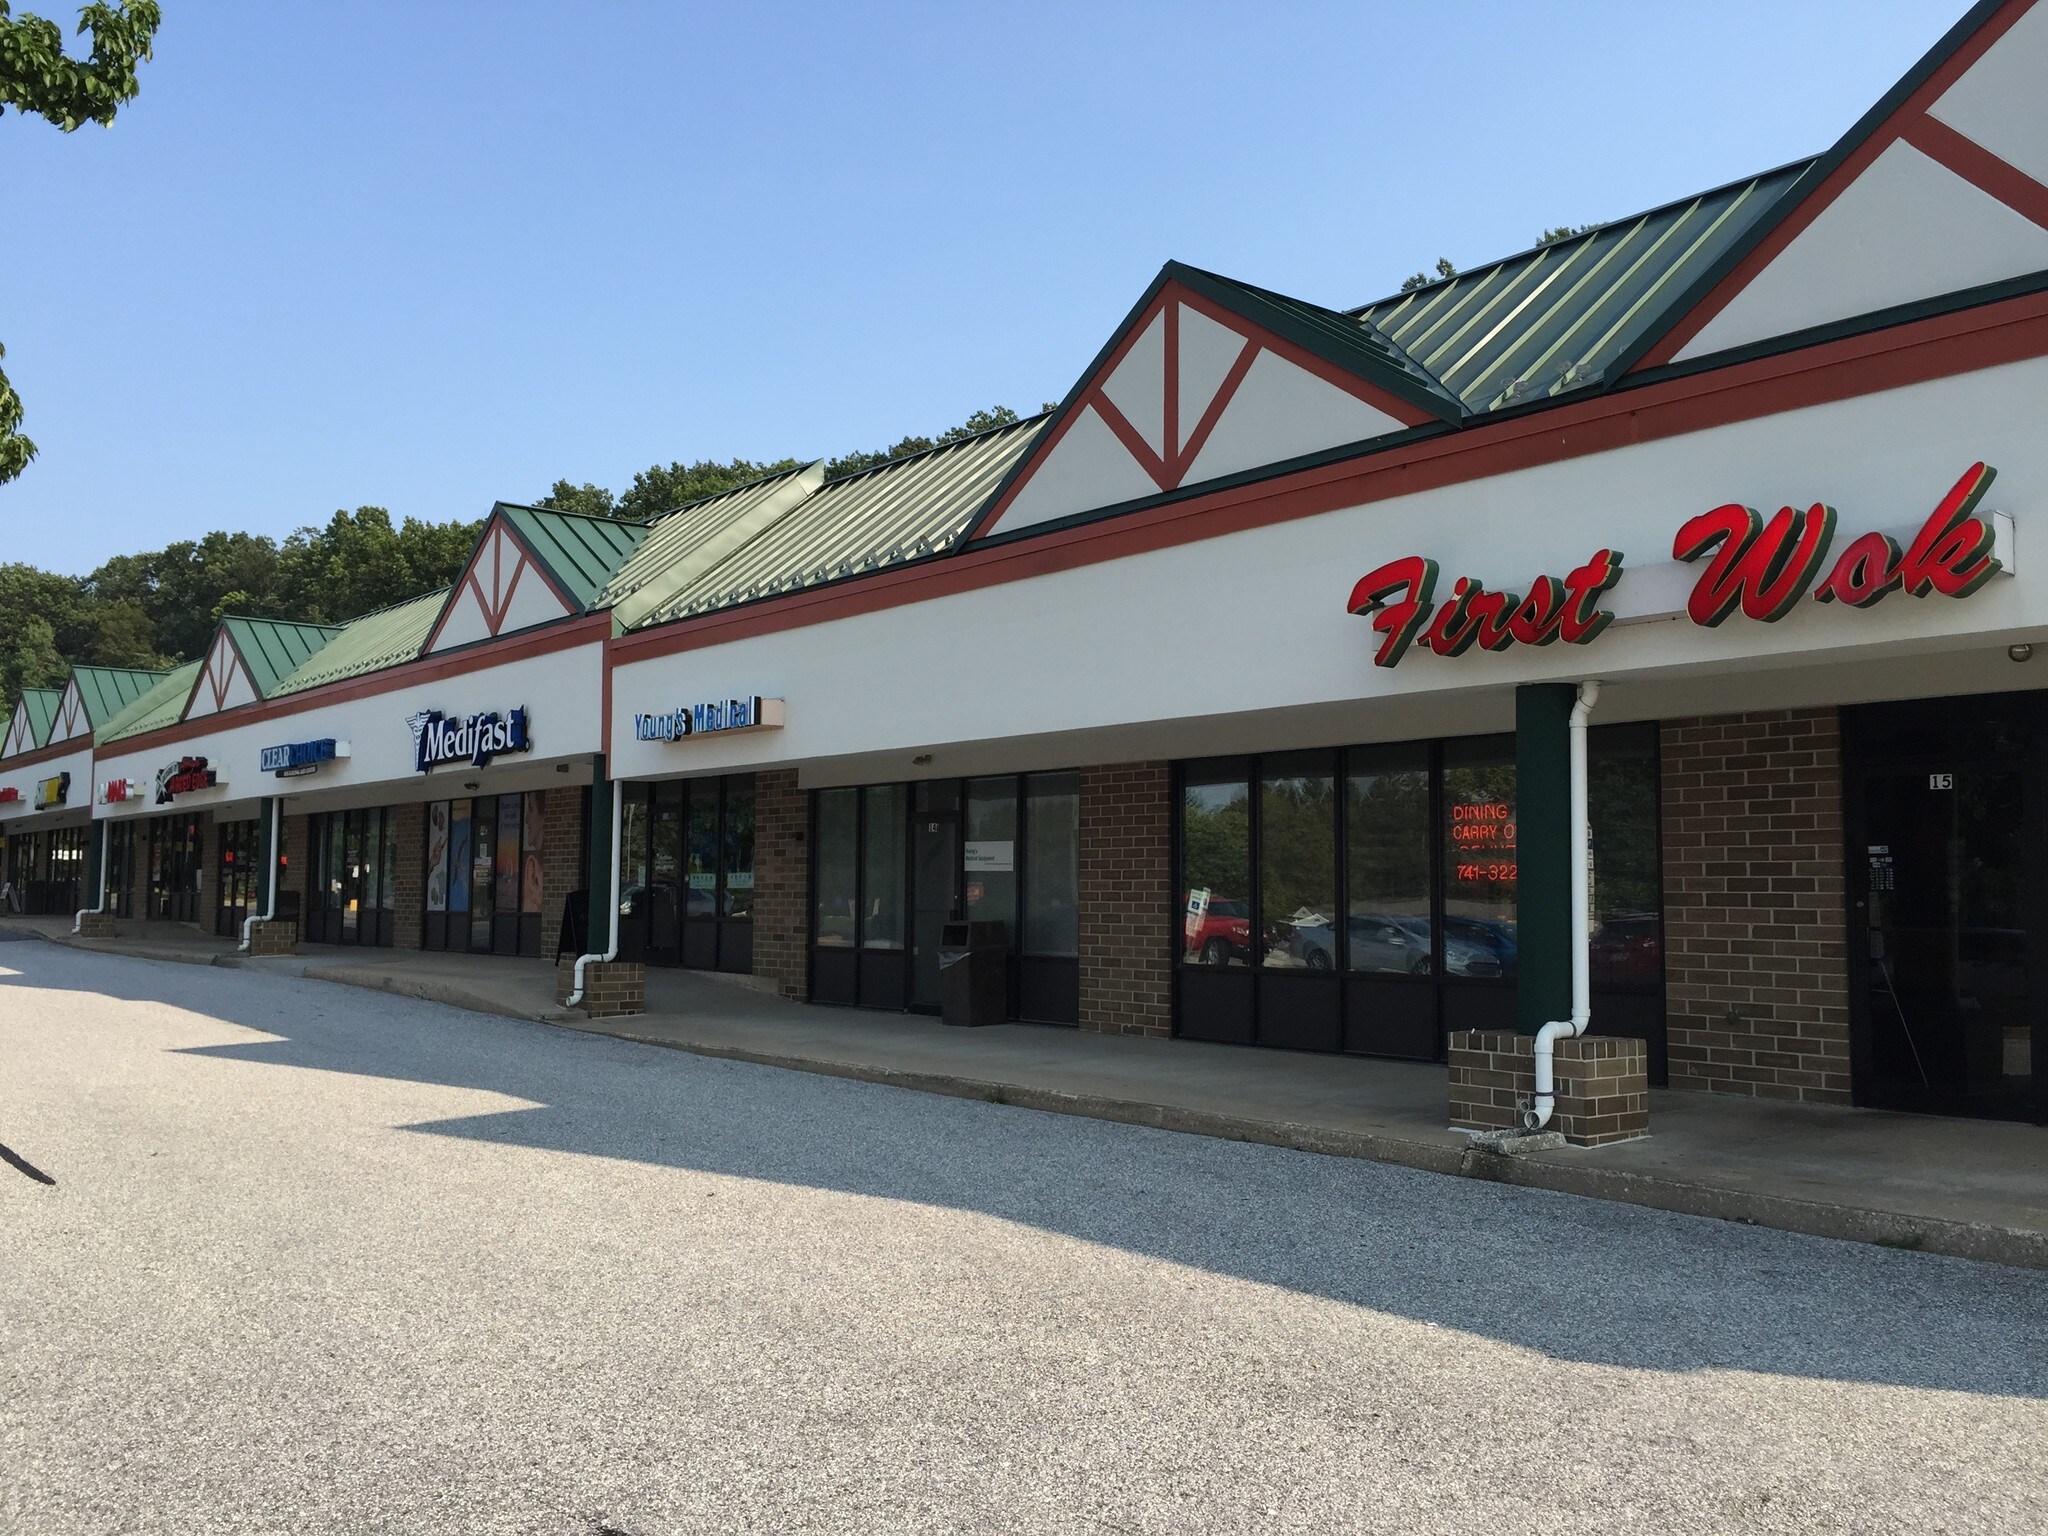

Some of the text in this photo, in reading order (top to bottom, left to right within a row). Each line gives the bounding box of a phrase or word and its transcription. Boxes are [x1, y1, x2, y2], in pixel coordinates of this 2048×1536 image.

[1347, 461, 2000, 668] First Wok
[635, 696, 756, 741] Young's Medical
[424, 711, 516, 766] Medifast
[1931, 775, 1952, 789] 15
[1453, 804, 1508, 820] DINING
[1453, 823, 1516, 840] CARRY O
[1457, 864, 1517, 881] 741-322
